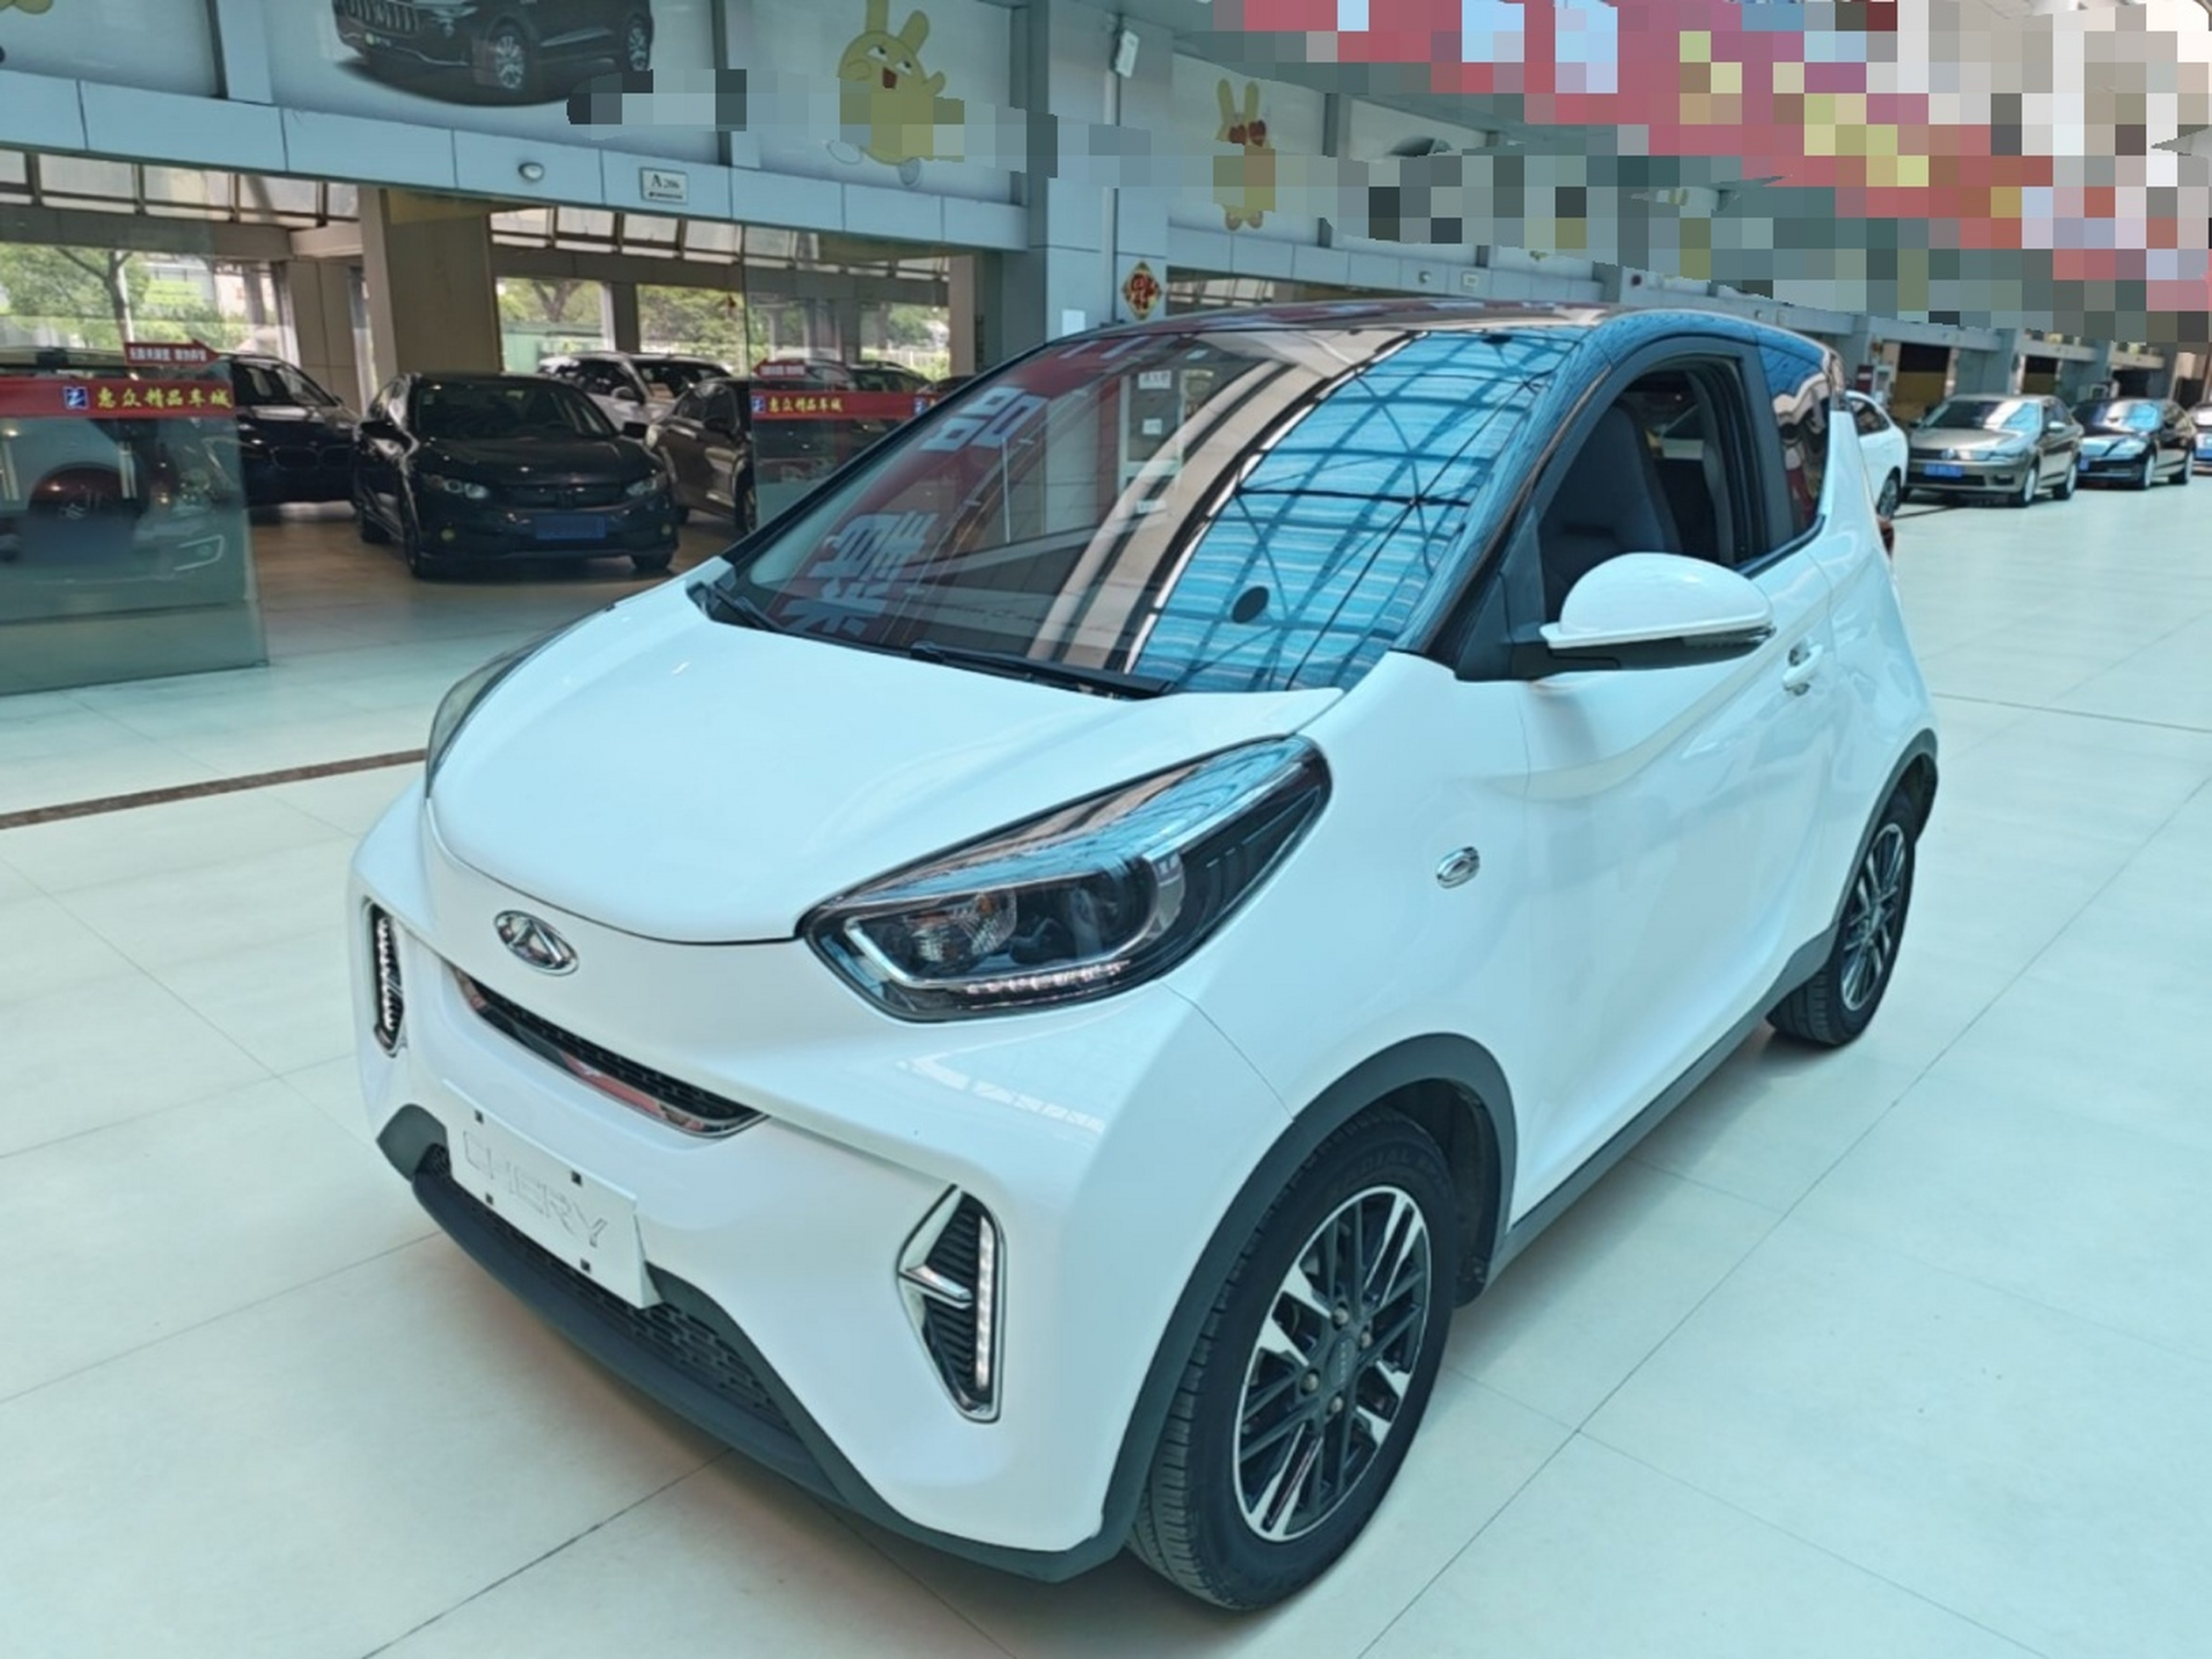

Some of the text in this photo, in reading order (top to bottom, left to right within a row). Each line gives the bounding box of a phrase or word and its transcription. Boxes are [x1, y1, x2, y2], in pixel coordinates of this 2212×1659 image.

[98, 387, 232, 409] 惠众精品车城
[463, 1130, 608, 1248] CHERY
